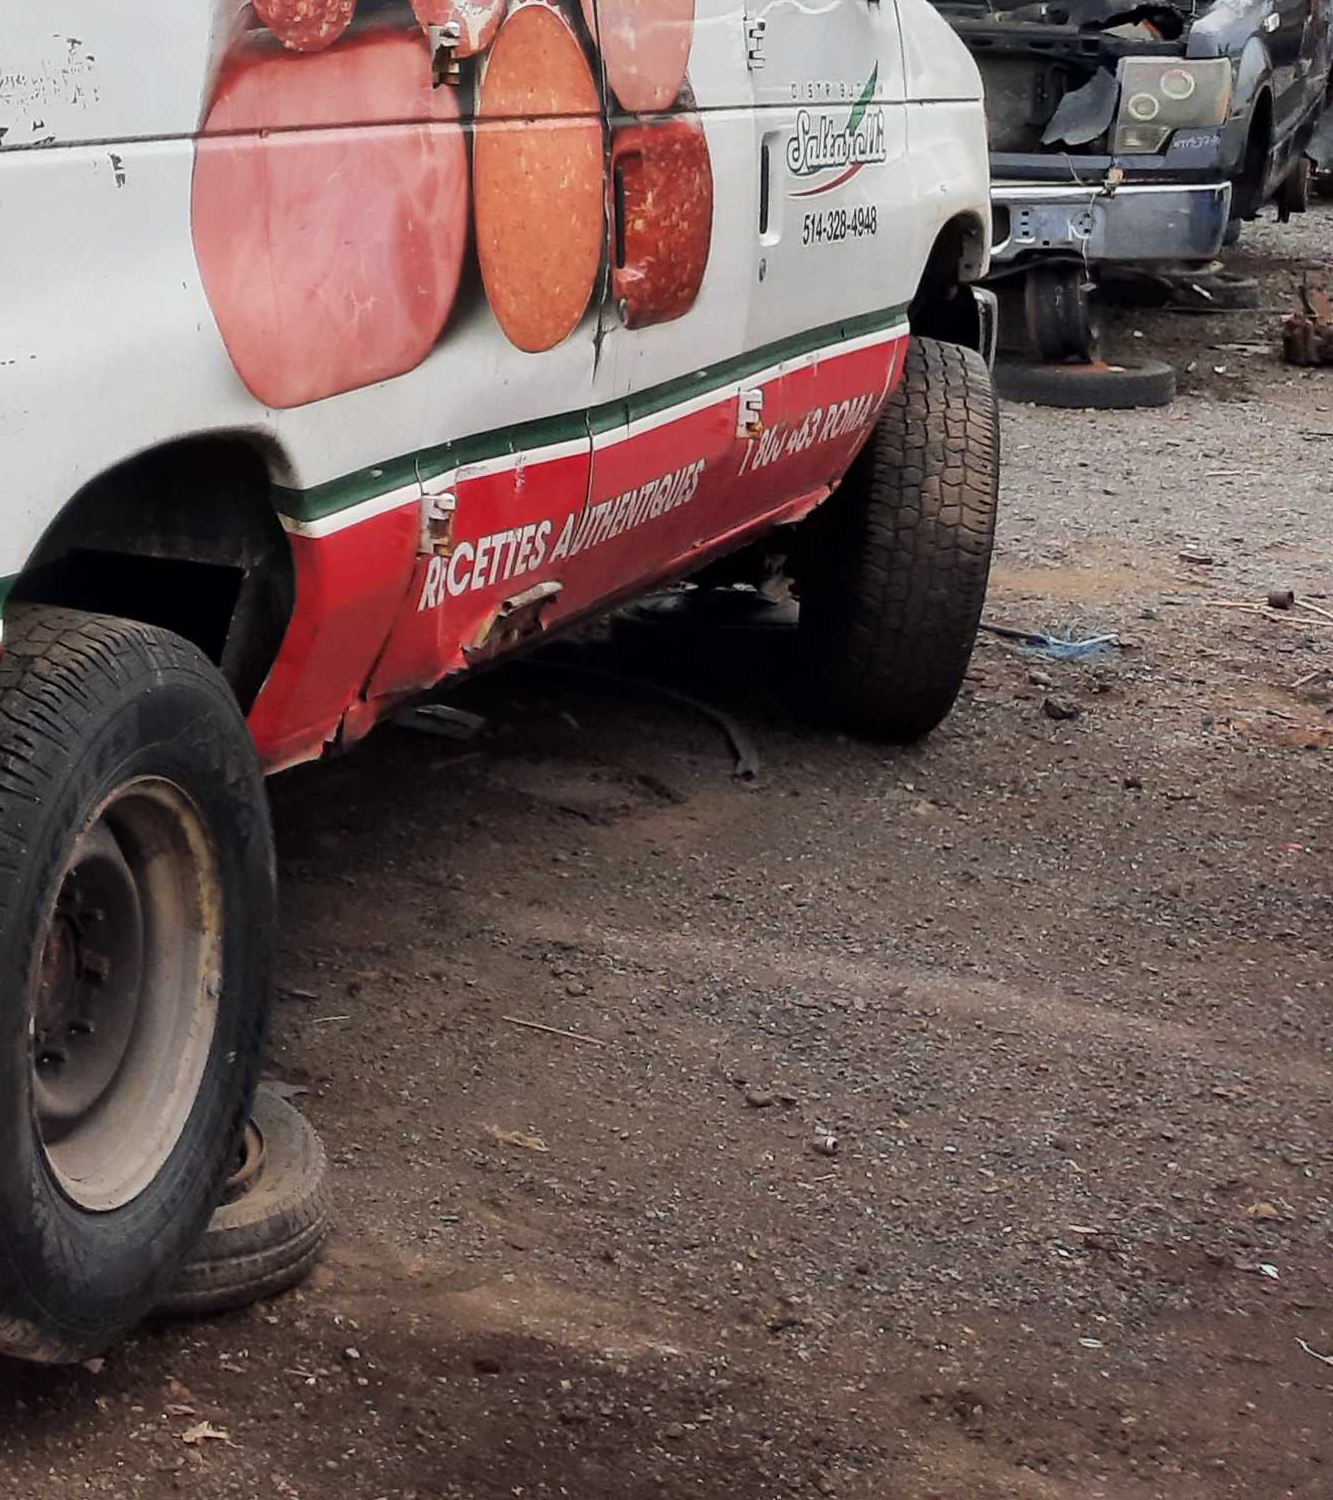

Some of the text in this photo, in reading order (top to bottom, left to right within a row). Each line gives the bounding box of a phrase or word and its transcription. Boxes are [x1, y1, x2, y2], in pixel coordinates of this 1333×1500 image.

[802, 205, 877, 245] 514-328-4948
[818, 393, 875, 443] ROMA
[417, 458, 707, 612] RECETTES AUTHENTIQUES
